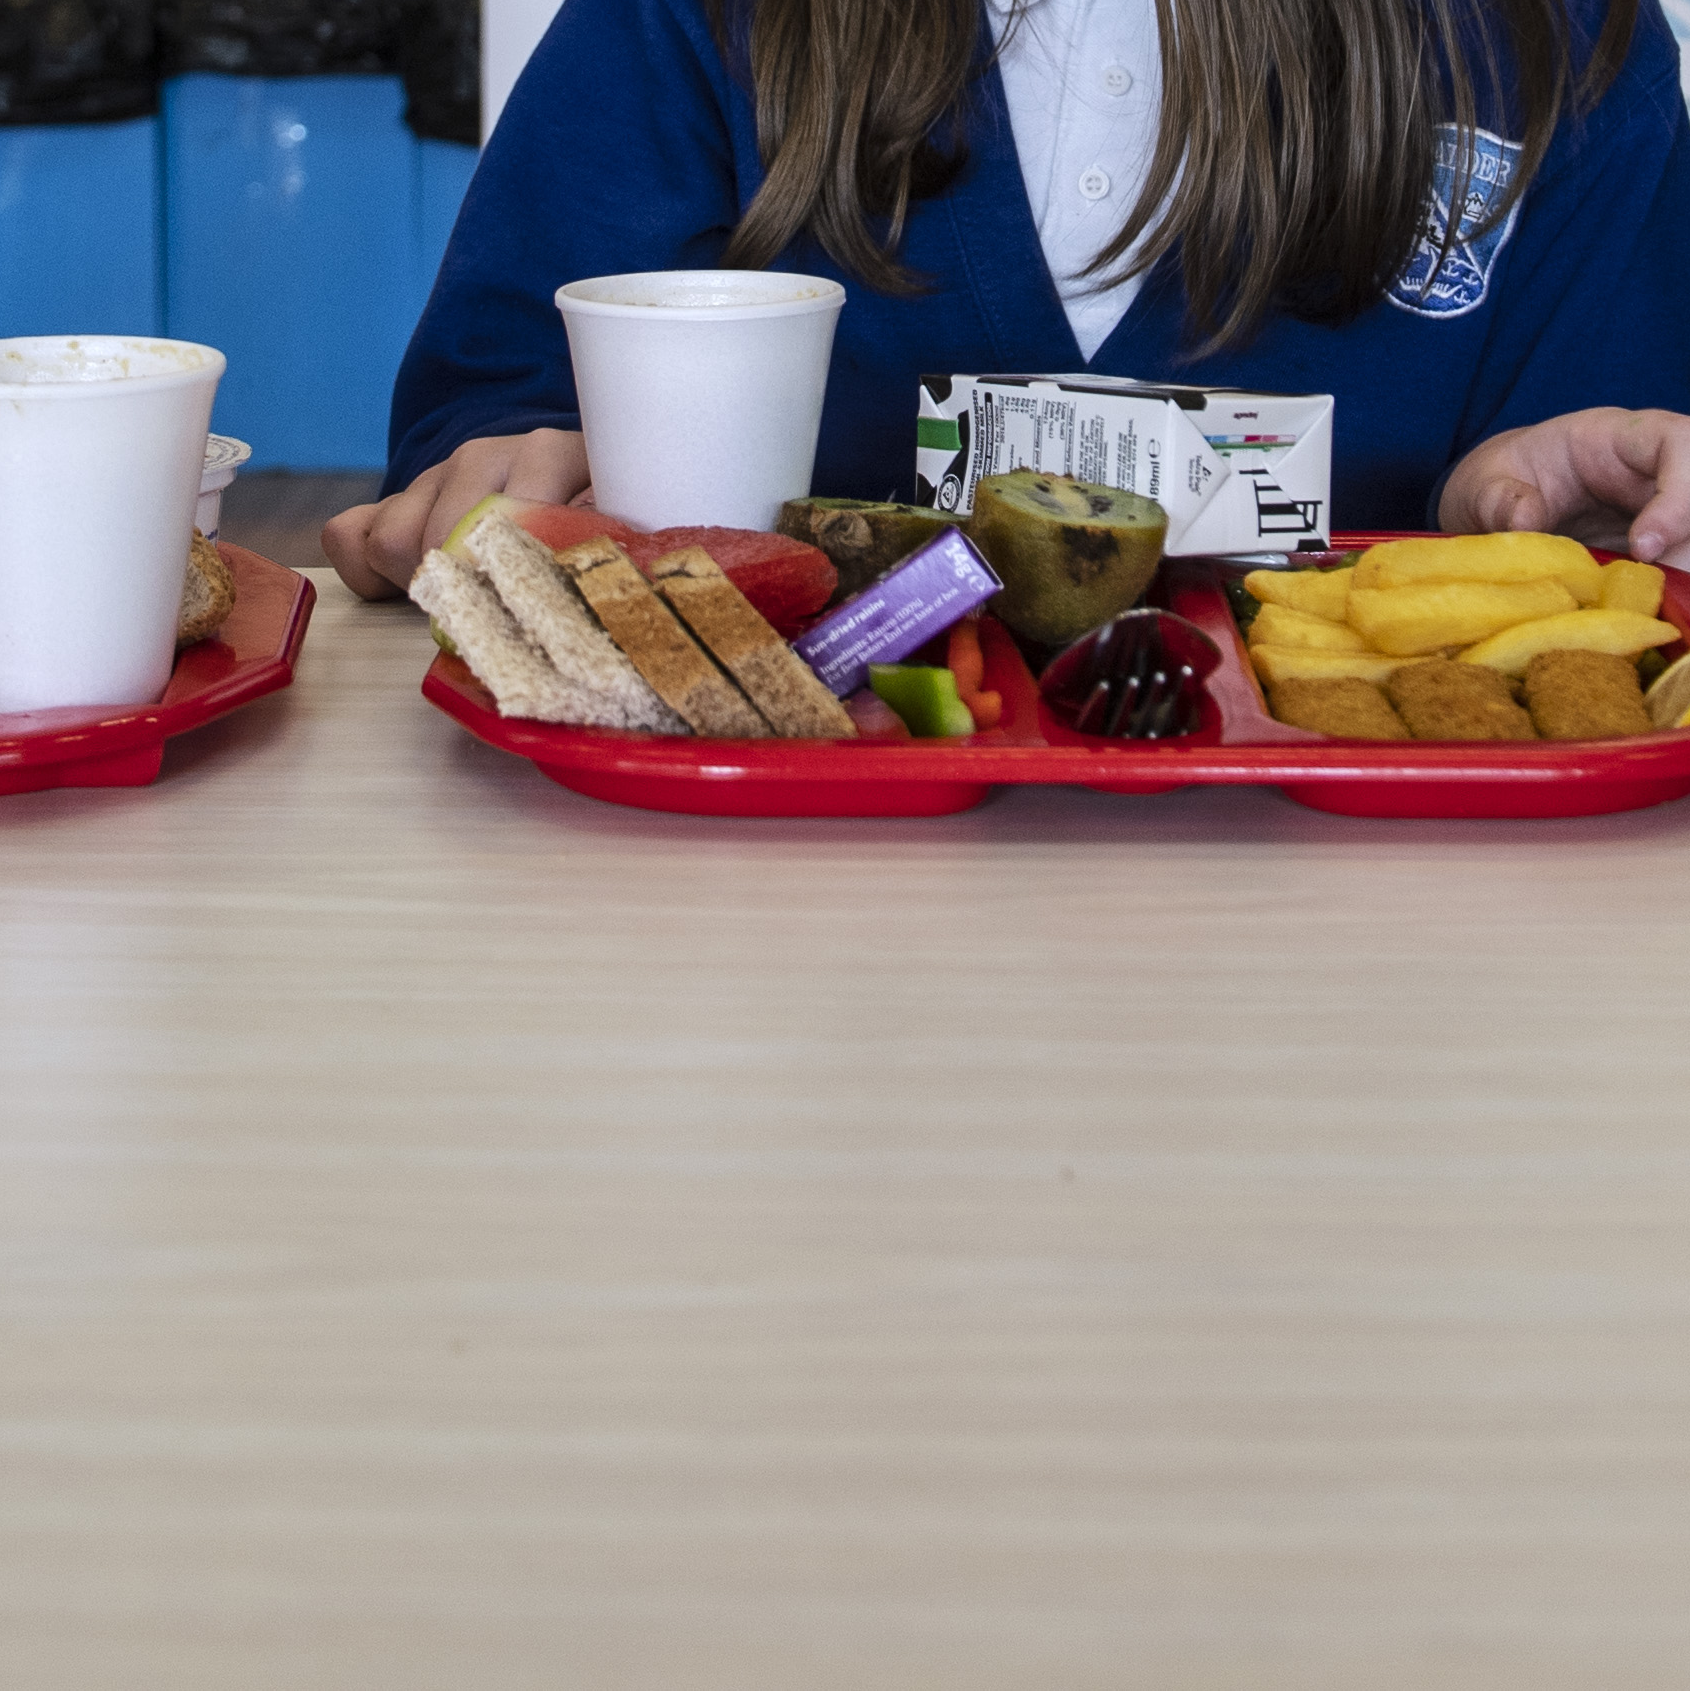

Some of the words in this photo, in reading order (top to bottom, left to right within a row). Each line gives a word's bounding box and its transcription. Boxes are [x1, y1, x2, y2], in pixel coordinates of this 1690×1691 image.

[967, 453, 979, 510] PASTEURISED
[942, 541, 975, 577] 14g
[806, 618, 855, 656] Sun-dried
[854, 597, 886, 623] raisins
[858, 637, 887, 661] Before
[884, 625, 903, 642] End
[901, 617, 917, 631] see
[914, 603, 934, 621] base
[867, 616, 898, 641] Raisins
